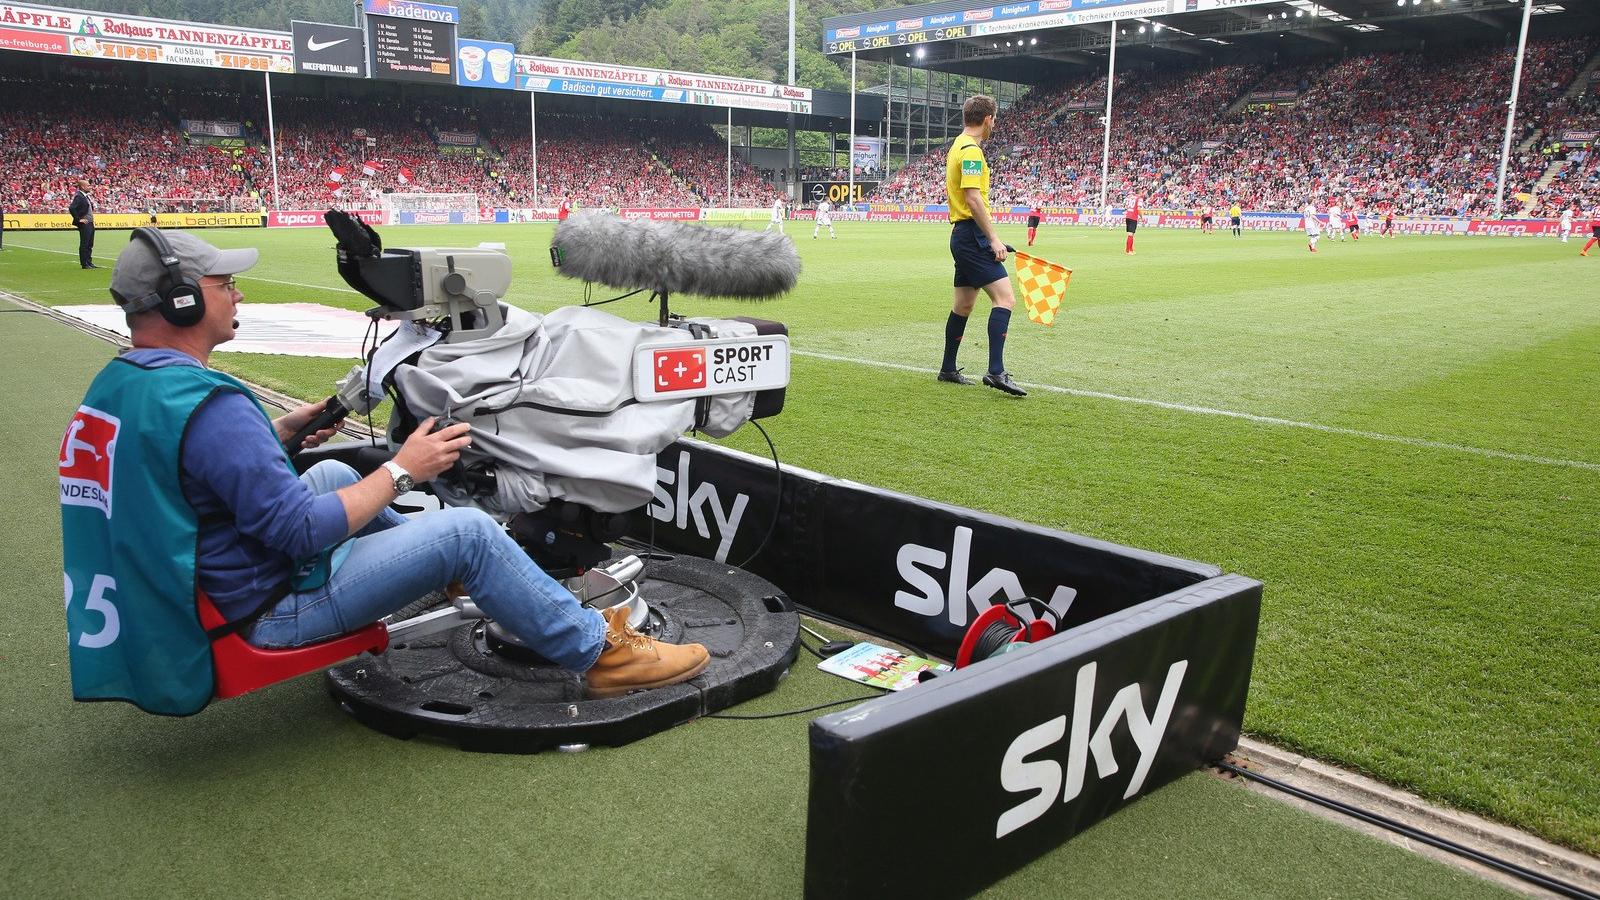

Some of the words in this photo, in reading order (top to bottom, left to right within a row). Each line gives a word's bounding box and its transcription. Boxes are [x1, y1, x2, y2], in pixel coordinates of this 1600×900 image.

[0, 6, 72, 30] ÄPFLE
[388, 3, 453, 22] badenova
[103, 18, 154, 38] Rothaus
[156, 27, 292, 51] TANNENZÄPFLE
[907, 32, 928, 43] OPEL
[945, 27, 967, 38] OPEL
[839, 42, 857, 52] OPEL
[872, 37, 891, 48] OPEL
[102, 44, 158, 61] ZIPSE
[174, 47, 205, 57] AUSBAU
[220, 54, 269, 70] ZIPSE
[302, 61, 359, 74] NIKEFOOTBALL.COM
[528, 61, 559, 75] Rothaus
[562, 66, 648, 83] TANNENZÄPFLE
[561, 80, 596, 93] Badisch
[598, 85, 611, 96] gut
[667, 74, 693, 88] Rothaus
[696, 79, 767, 95] TANNENZÄPFLE
[829, 184, 863, 202] OPEL
[185, 216, 260, 226] baden.fm
[277, 212, 316, 225] tipico
[531, 209, 557, 220] Rothau
[653, 211, 695, 219] SPORTWETTEN
[1477, 221, 1528, 233] tipico
[713, 344, 773, 365] SPORT
[713, 365, 757, 384] CAST
[646, 450, 749, 564] sky
[996, 660, 1188, 839] sky
